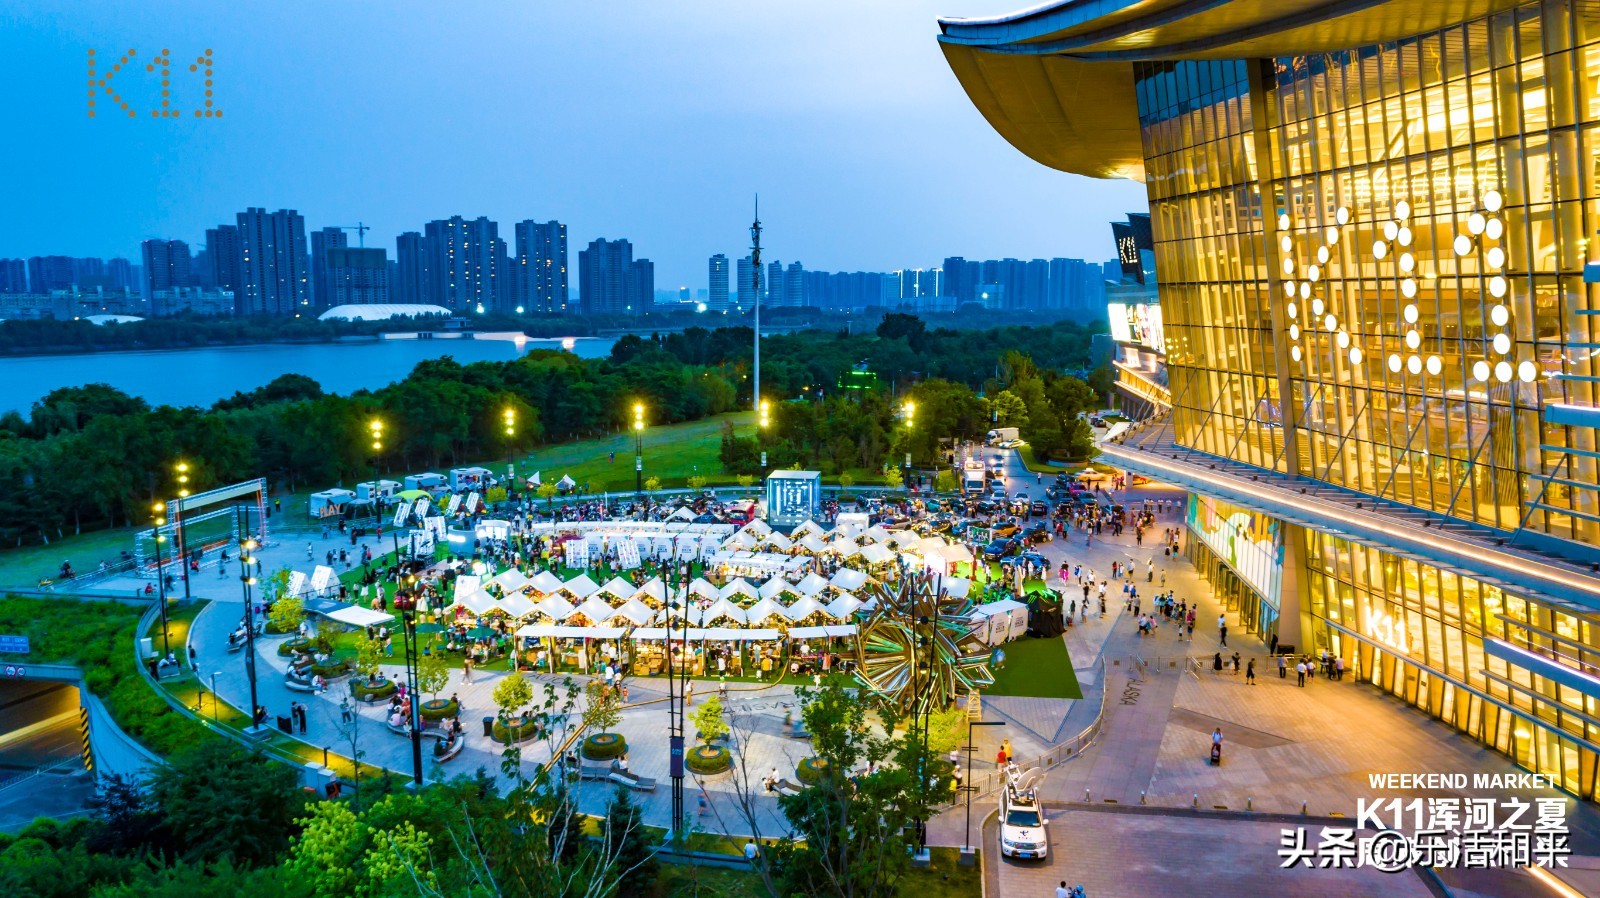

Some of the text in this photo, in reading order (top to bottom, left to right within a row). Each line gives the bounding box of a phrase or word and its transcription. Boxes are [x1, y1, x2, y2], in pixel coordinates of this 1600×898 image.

[1119, 236, 1138, 264] K11
[1279, 190, 1538, 383] K11
[1365, 605, 1410, 654] K11
